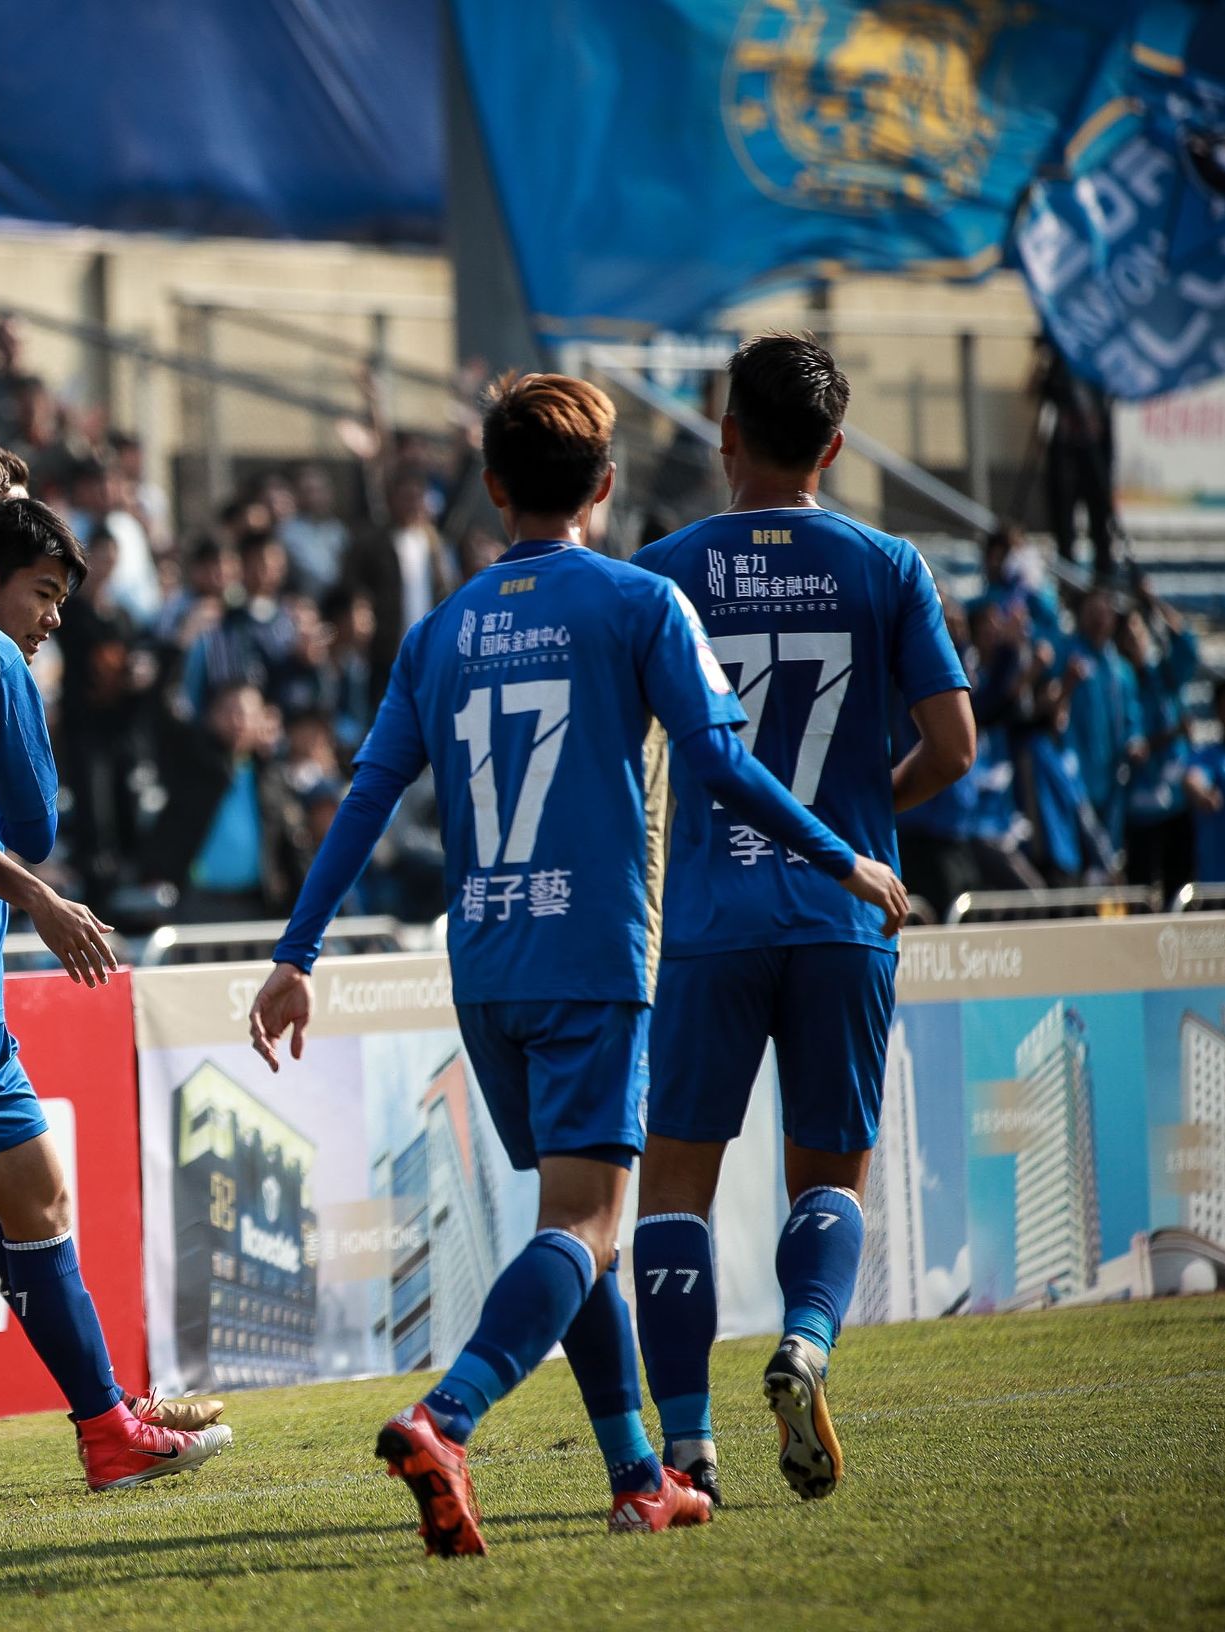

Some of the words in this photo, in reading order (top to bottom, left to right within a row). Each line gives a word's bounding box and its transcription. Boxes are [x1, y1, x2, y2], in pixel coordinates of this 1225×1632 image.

[733, 554, 767, 574] 富力
[735, 574, 838, 598] 国际金融中心
[481, 610, 513, 633] 富力
[479, 624, 571, 657] 国际金融中心
[710, 632, 853, 810] 77
[453, 679, 571, 868] 17
[957, 938, 1023, 980] Service
[789, 1212, 841, 1234] 77
[646, 1268, 700, 1295] 77
